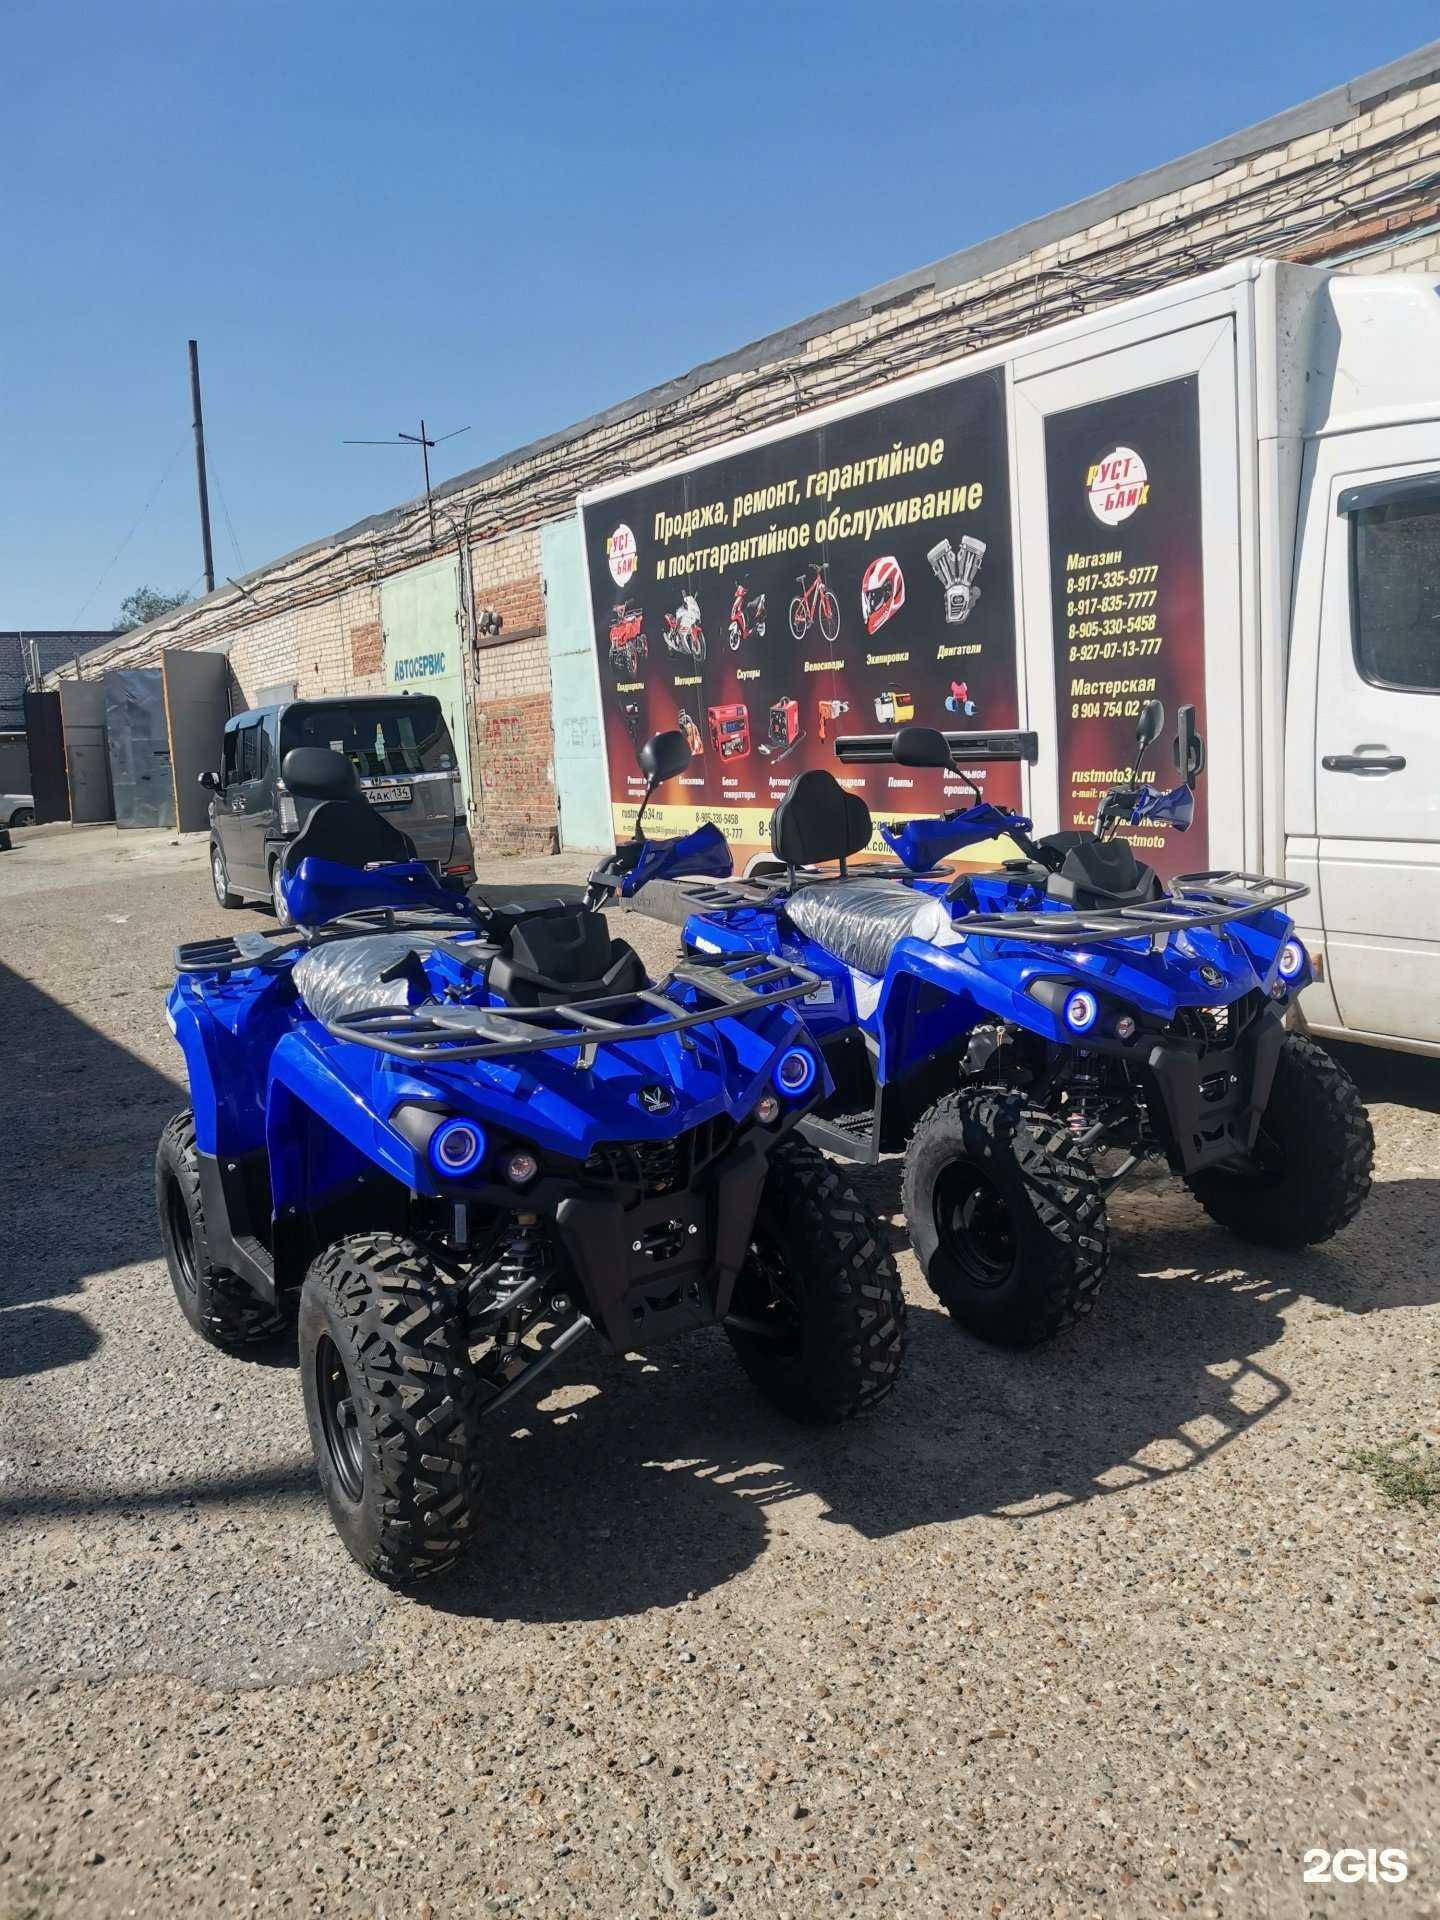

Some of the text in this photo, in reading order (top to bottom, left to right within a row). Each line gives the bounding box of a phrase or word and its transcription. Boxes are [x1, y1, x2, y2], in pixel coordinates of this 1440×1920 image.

[655, 438, 945, 541] Продажа, ремонт, гарантийное
[656, 481, 984, 581] и постгарантийное обслуживание
[1066, 550, 1122, 571] Магазин
[1066, 565, 1159, 594] 8-917-335-9777
[1067, 590, 1157, 617] 8-917-835-7777
[1068, 614, 1156, 640] 8-905-330-5458
[867, 651, 909, 666] Экипировка
[937, 644, 982, 659] Двигатели
[1069, 637, 1162, 662] 8-927-07-13-777
[395, 652, 446, 681] АВТОСЕРВИС
[1071, 678, 1156, 698] Мастерская
[1071, 703, 1079, 718] 8
[1081, 702, 1100, 718] 904
[1103, 701, 1122, 717] 754
[1124, 700, 1140, 716] 02
